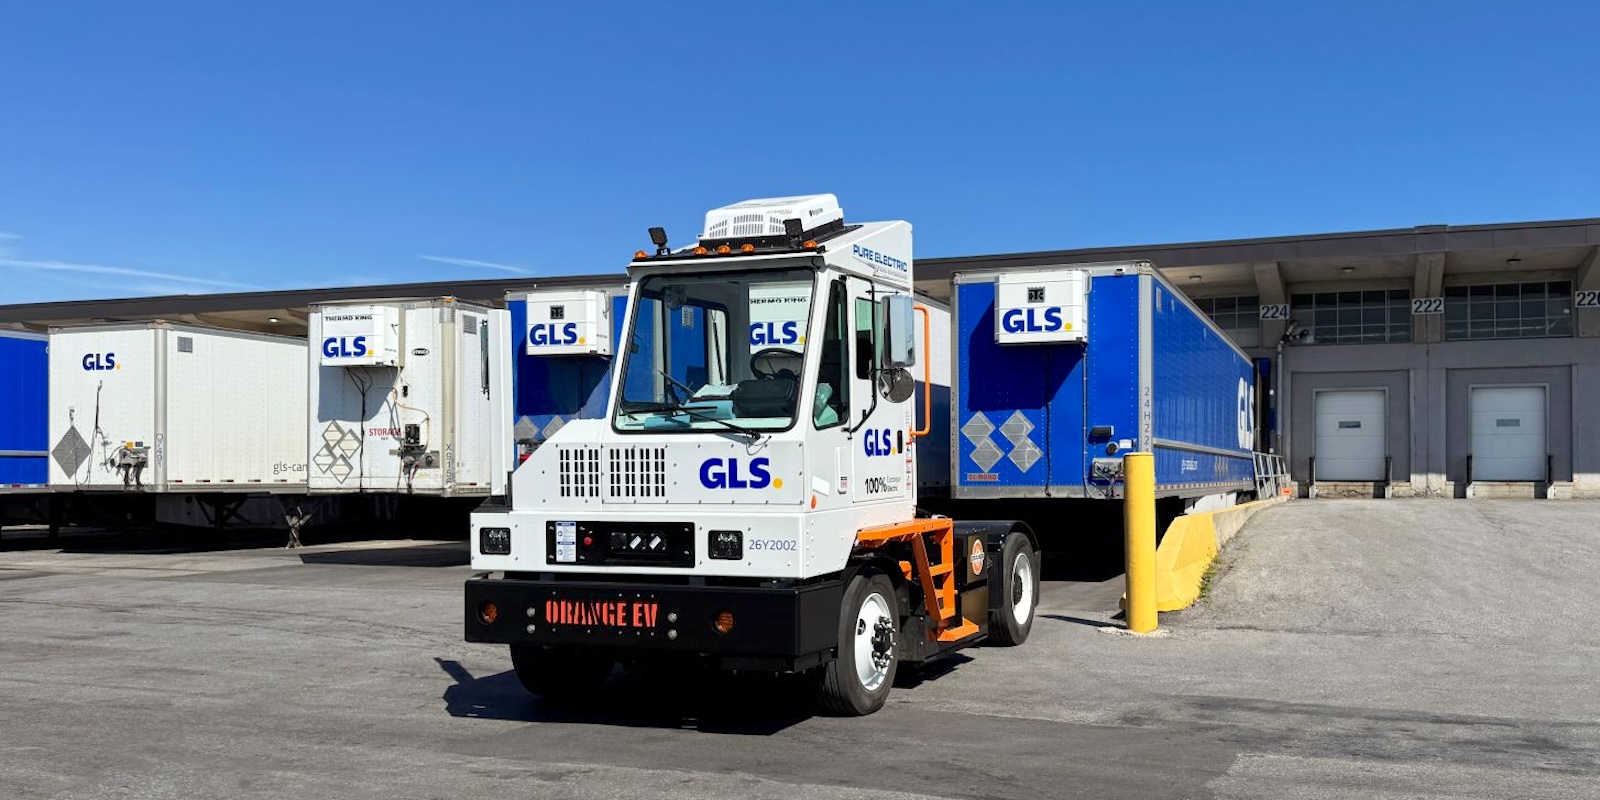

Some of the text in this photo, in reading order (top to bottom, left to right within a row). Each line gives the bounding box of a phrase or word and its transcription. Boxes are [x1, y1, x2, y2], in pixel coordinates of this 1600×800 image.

[853, 244, 908, 273] PURE ELECTRIC
[1576, 291, 1600, 306] 22
[1261, 305, 1289, 319] 224
[1413, 299, 1443, 314] 222
[864, 477, 887, 494] 100%
[749, 540, 797, 551] 26Y2002
[546, 600, 658, 628] ORANGE EV
